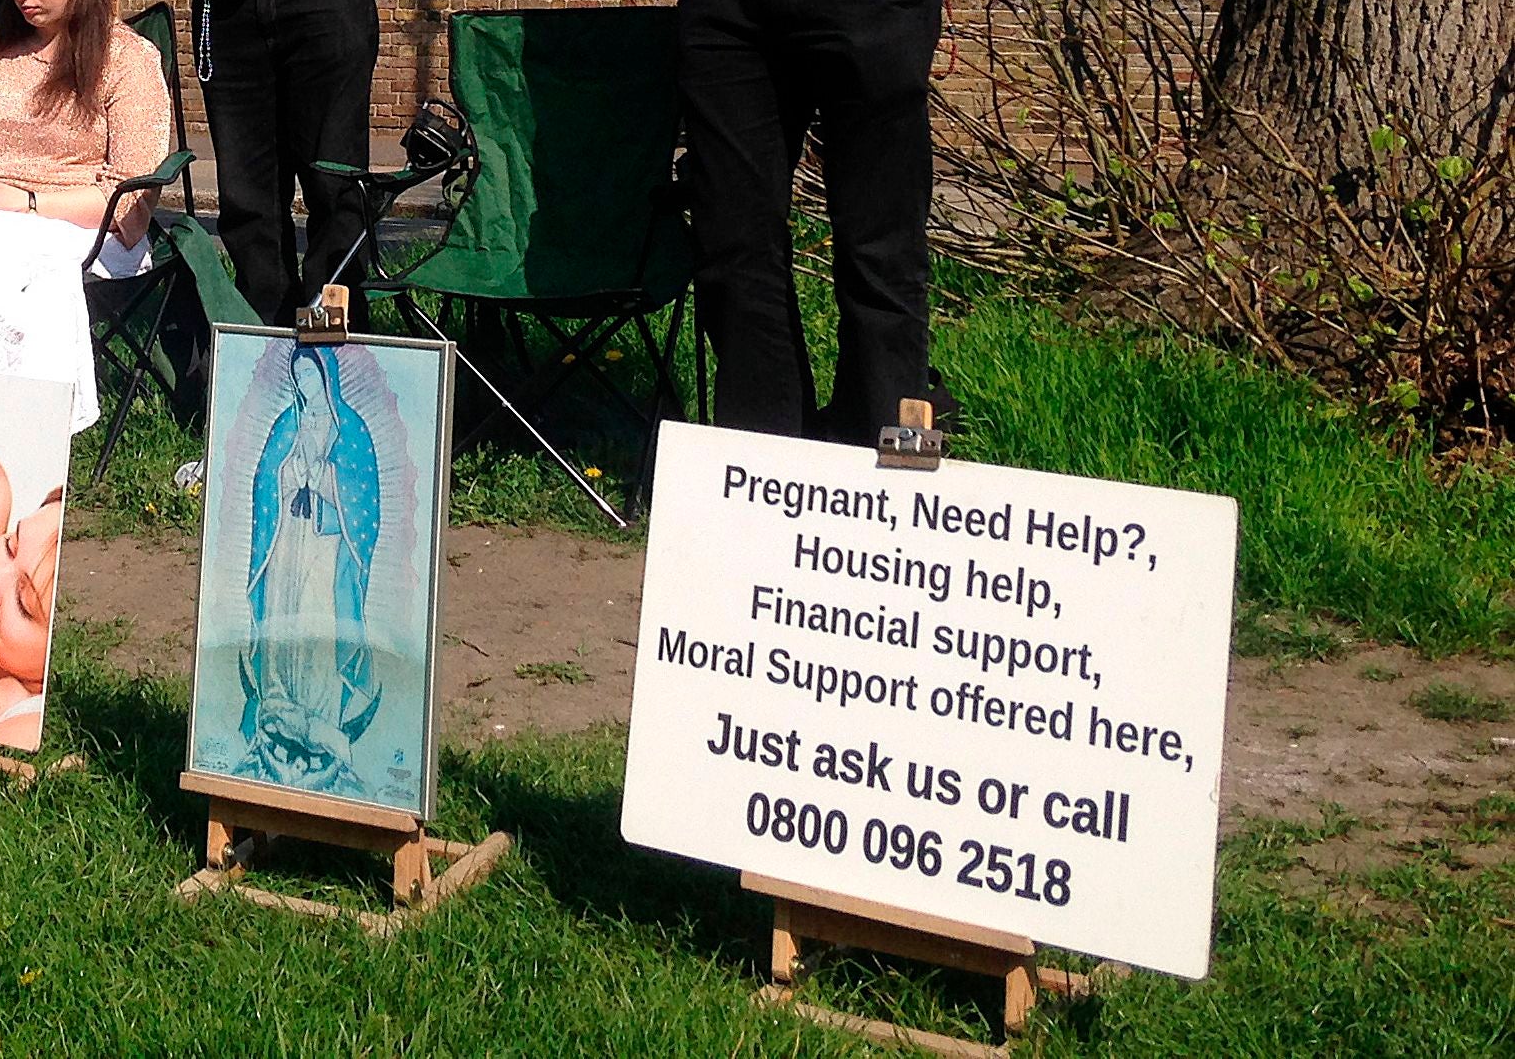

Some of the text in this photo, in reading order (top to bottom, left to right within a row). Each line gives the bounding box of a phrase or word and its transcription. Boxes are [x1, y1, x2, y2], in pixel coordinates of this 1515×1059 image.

[723, 464, 1157, 572] Pregnant, Need Help?,
[794, 533, 1061, 620] Housing help,
[751, 584, 1101, 690] Financial support,
[657, 626, 1193, 773] Moral Support offered here,
[706, 712, 1130, 843] Just ask us or call
[746, 792, 1072, 907] 0800 096 2518
